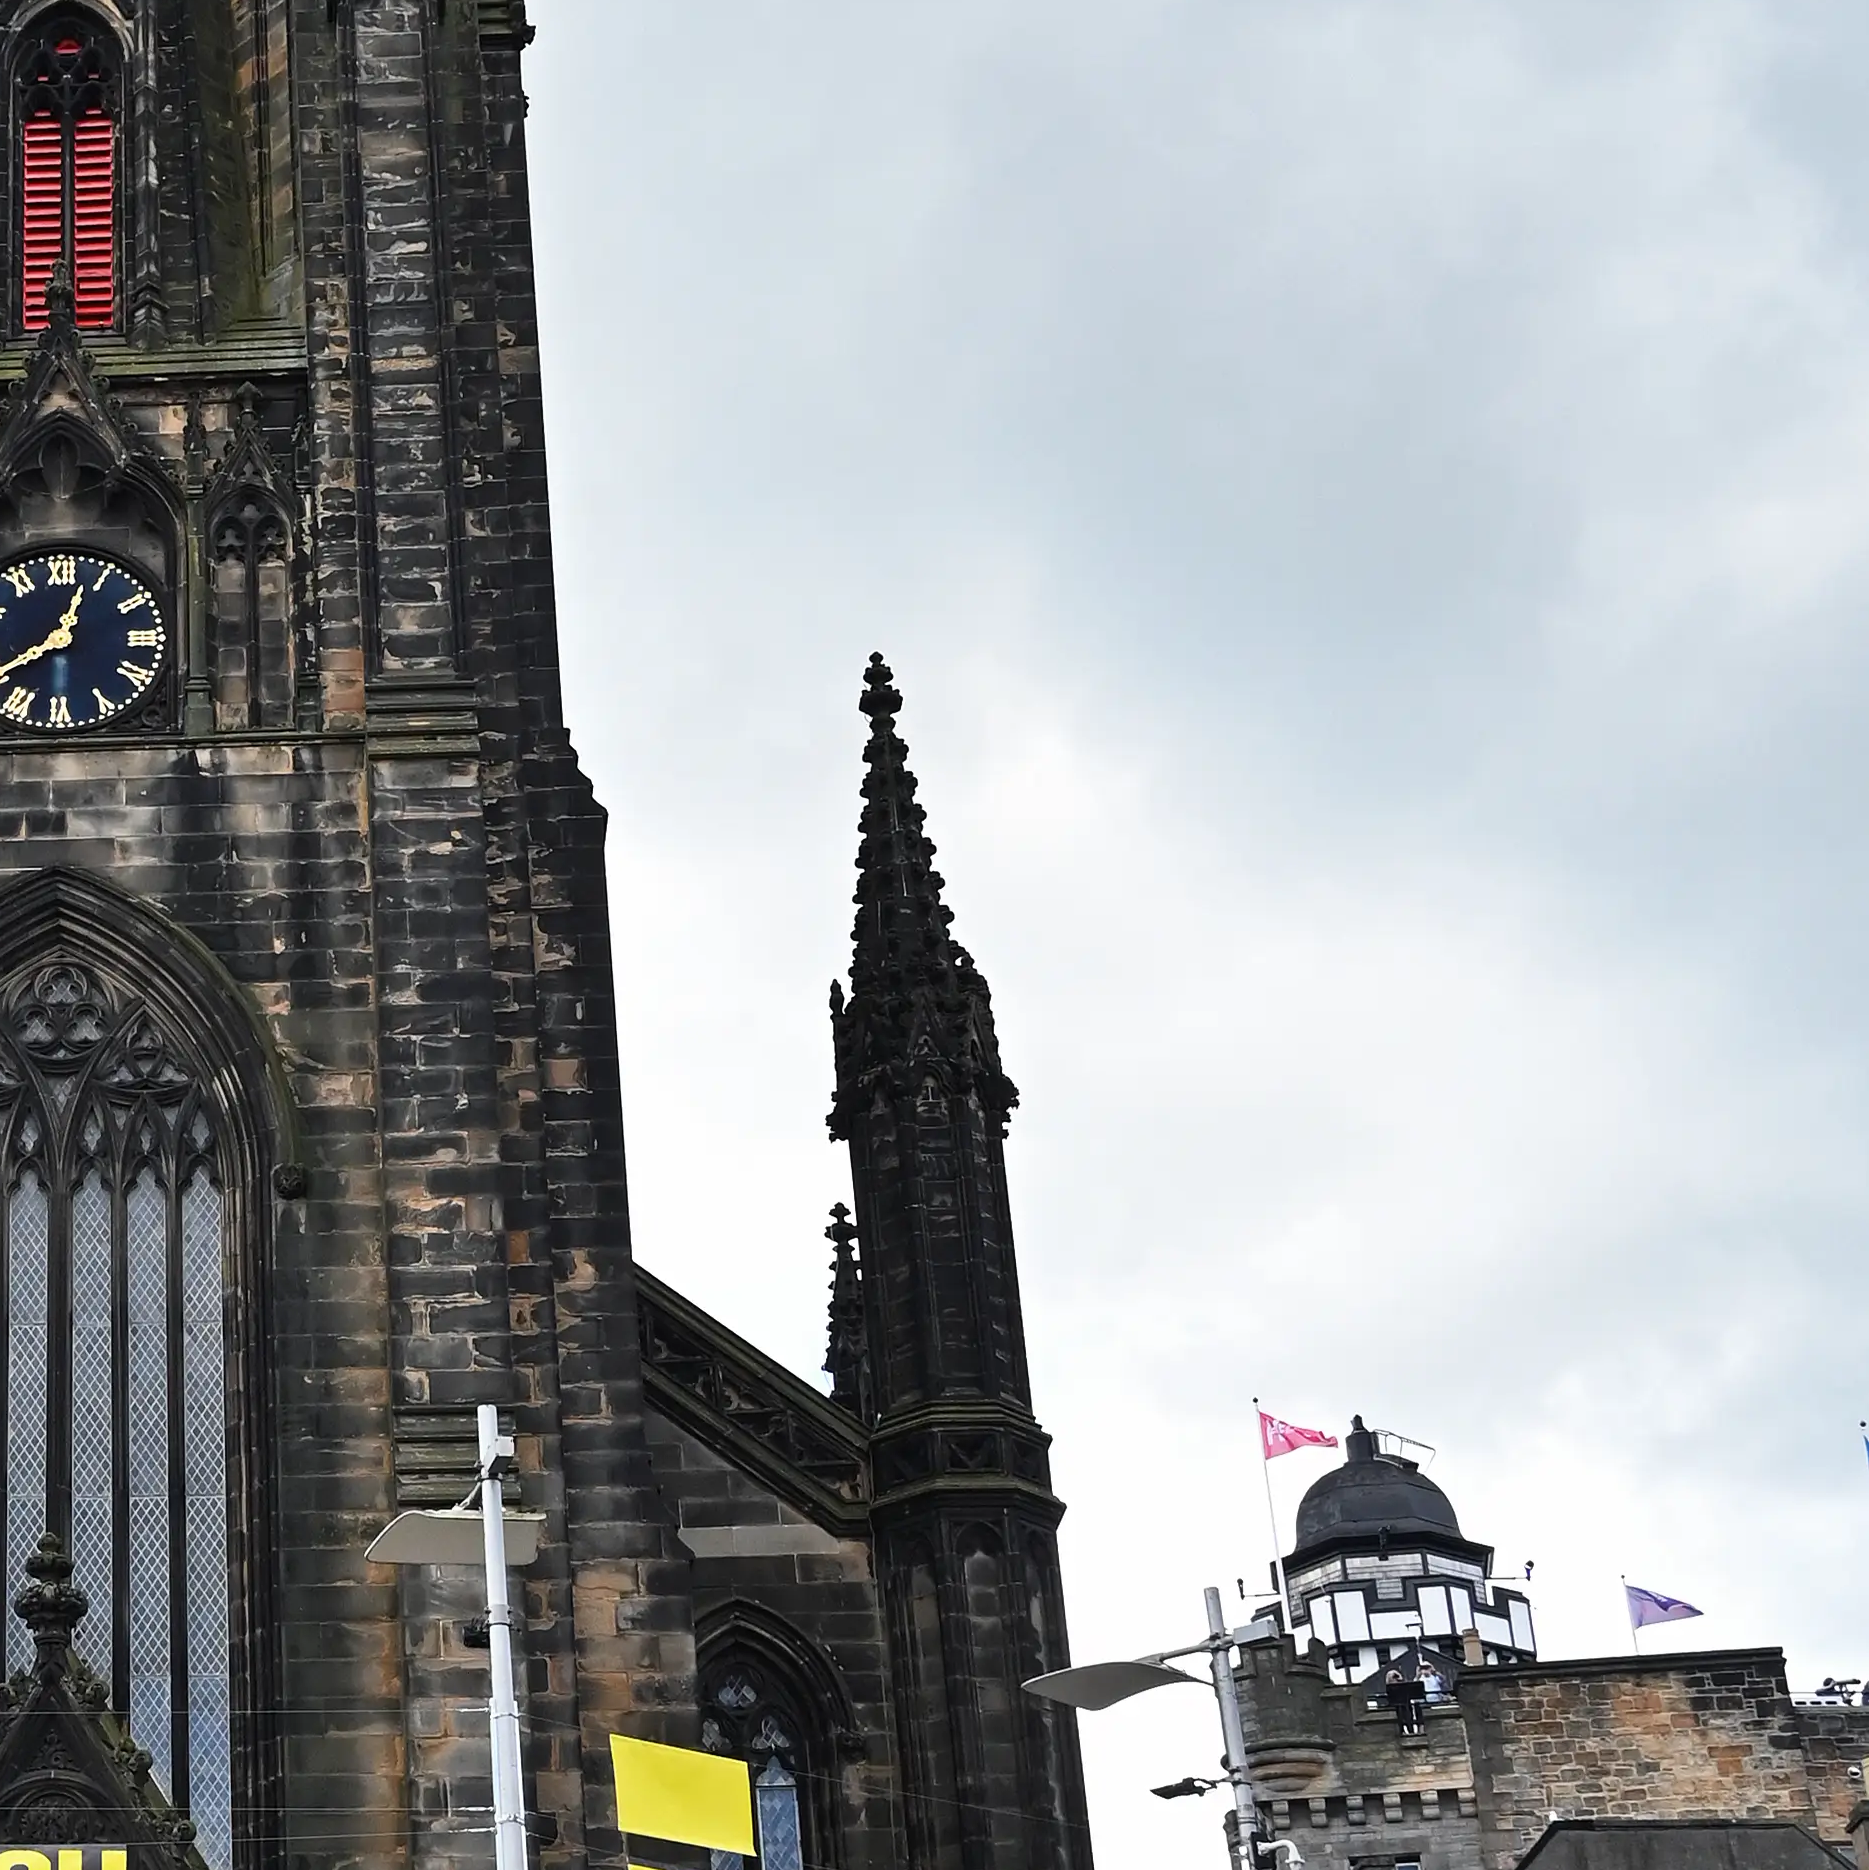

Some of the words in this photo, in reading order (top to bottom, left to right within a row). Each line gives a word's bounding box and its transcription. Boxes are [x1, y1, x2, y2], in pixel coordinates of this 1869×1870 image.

[6, 567, 35, 598] XI
[47, 559, 75, 585] XII
[93, 566, 111, 591] I
[117, 593, 147, 614] II
[127, 630, 157, 646] III
[3, 686, 35, 717] VII
[50, 696, 71, 722] VI
[92, 687, 115, 712] V
